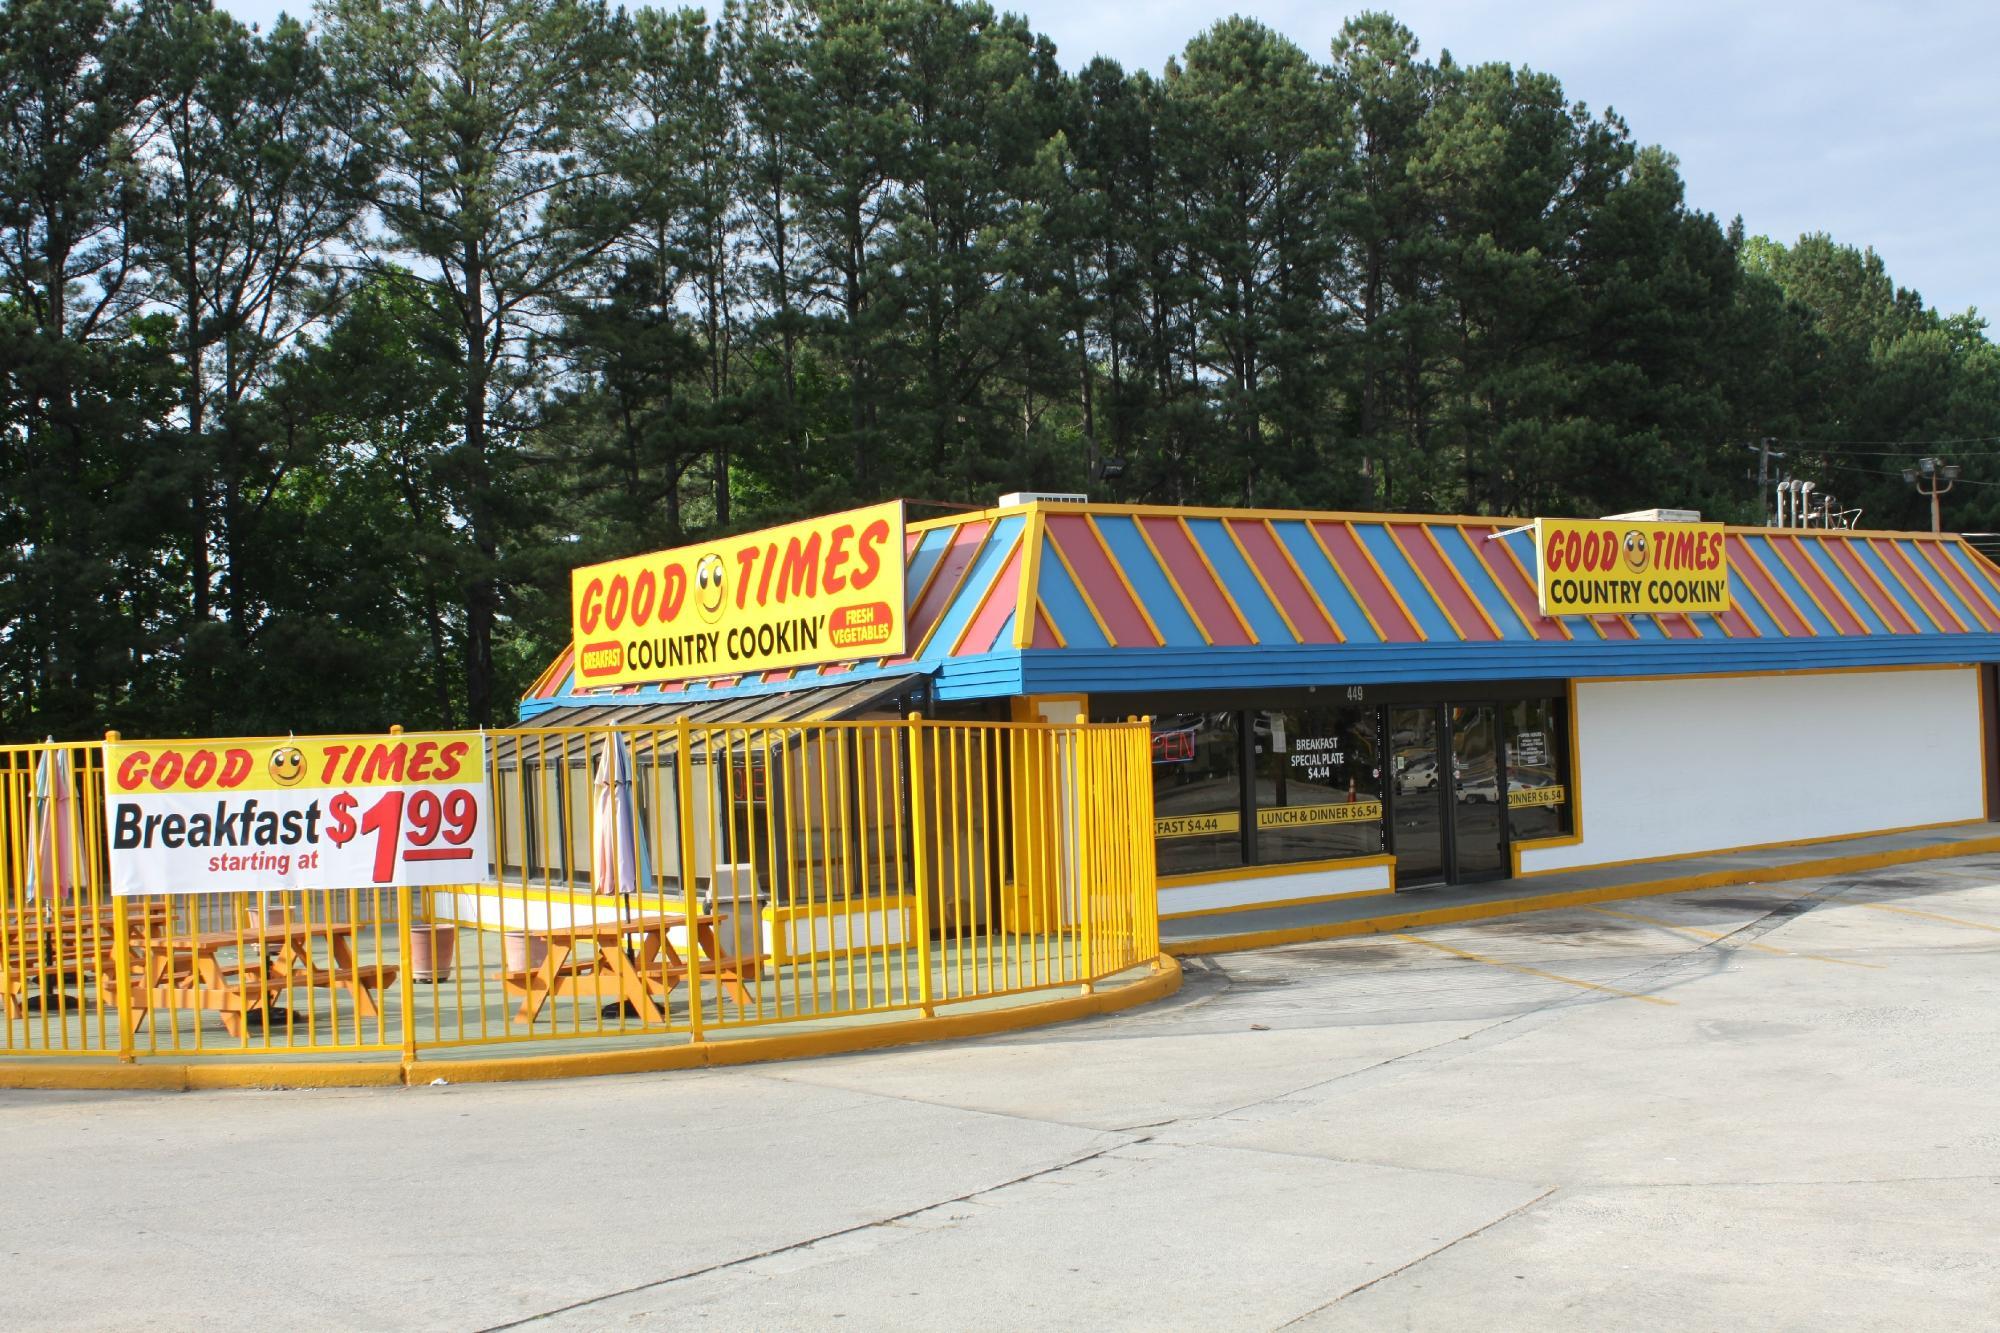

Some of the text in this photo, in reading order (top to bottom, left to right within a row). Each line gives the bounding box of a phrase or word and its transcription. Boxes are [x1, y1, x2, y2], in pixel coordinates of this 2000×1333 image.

[1547, 529, 1722, 572] GOOD TIMES
[580, 519, 889, 635] GOOD TIMES
[1551, 579, 1725, 604] COUNTRY COOKIN'
[846, 607, 874, 626] FRESH
[627, 615, 826, 671] COUNTRY COOKIN'
[832, 623, 889, 645] VEGETABLES
[583, 648, 620, 670] BREAKFAST
[1347, 686, 1363, 701] 449
[1296, 737, 1338, 751] BREAKFAST
[117, 741, 469, 790] GOOD TIMES
[1291, 752, 1345, 767] SPECIAL PLATE
[1308, 766, 1330, 780] $4.44
[1538, 790, 1561, 801] $6.54
[113, 798, 321, 850] Breakfast
[1187, 819, 1217, 832] $4.44
[1261, 805, 1377, 825] LUNCH & DINNER $6.54
[208, 849, 318, 875] starting at
